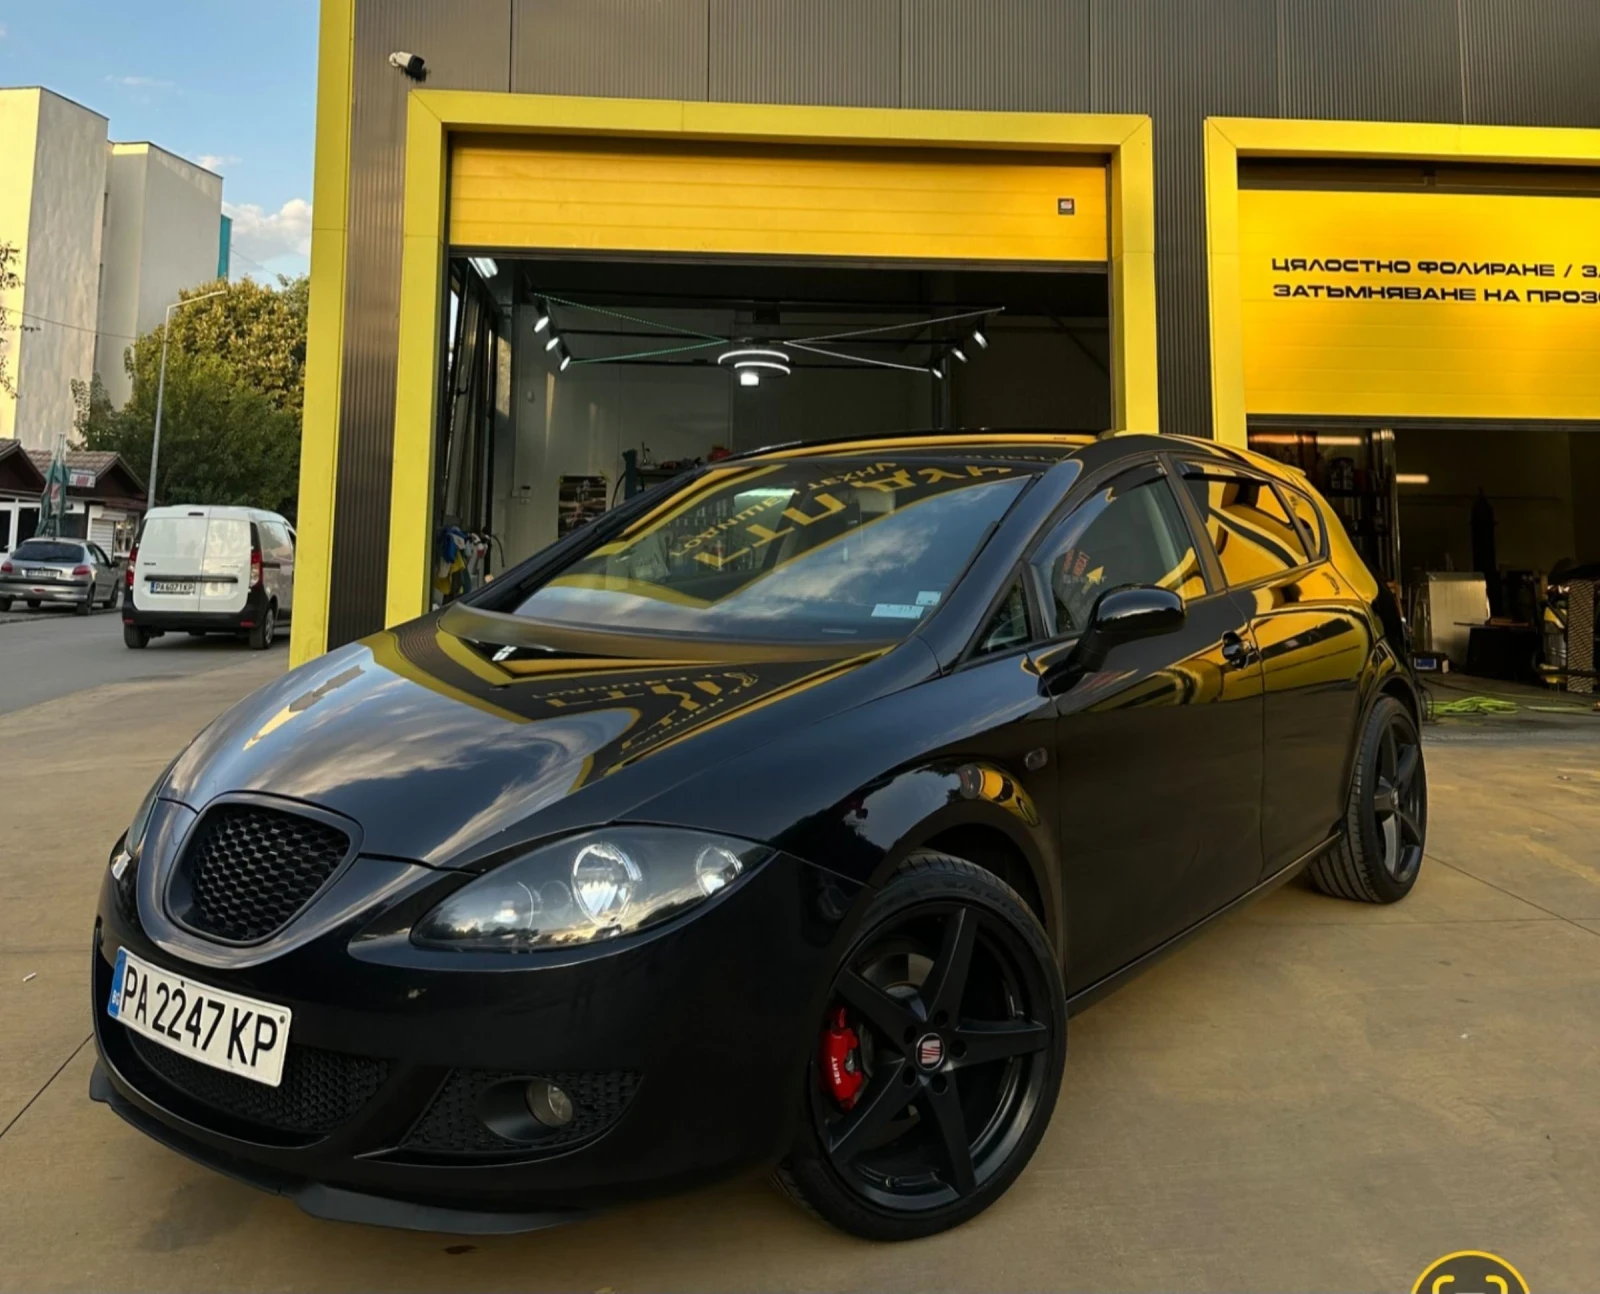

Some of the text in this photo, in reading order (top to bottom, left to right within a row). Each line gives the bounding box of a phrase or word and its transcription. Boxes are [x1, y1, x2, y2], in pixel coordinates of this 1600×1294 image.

[1272, 258, 1411, 274] ЦЯЛОСТНО
[1417, 261, 1555, 277] ФОЛИРАНЕ
[1273, 284, 1600, 304] ЗАТЪМНЯВАНЕ НА ПРОЗ
